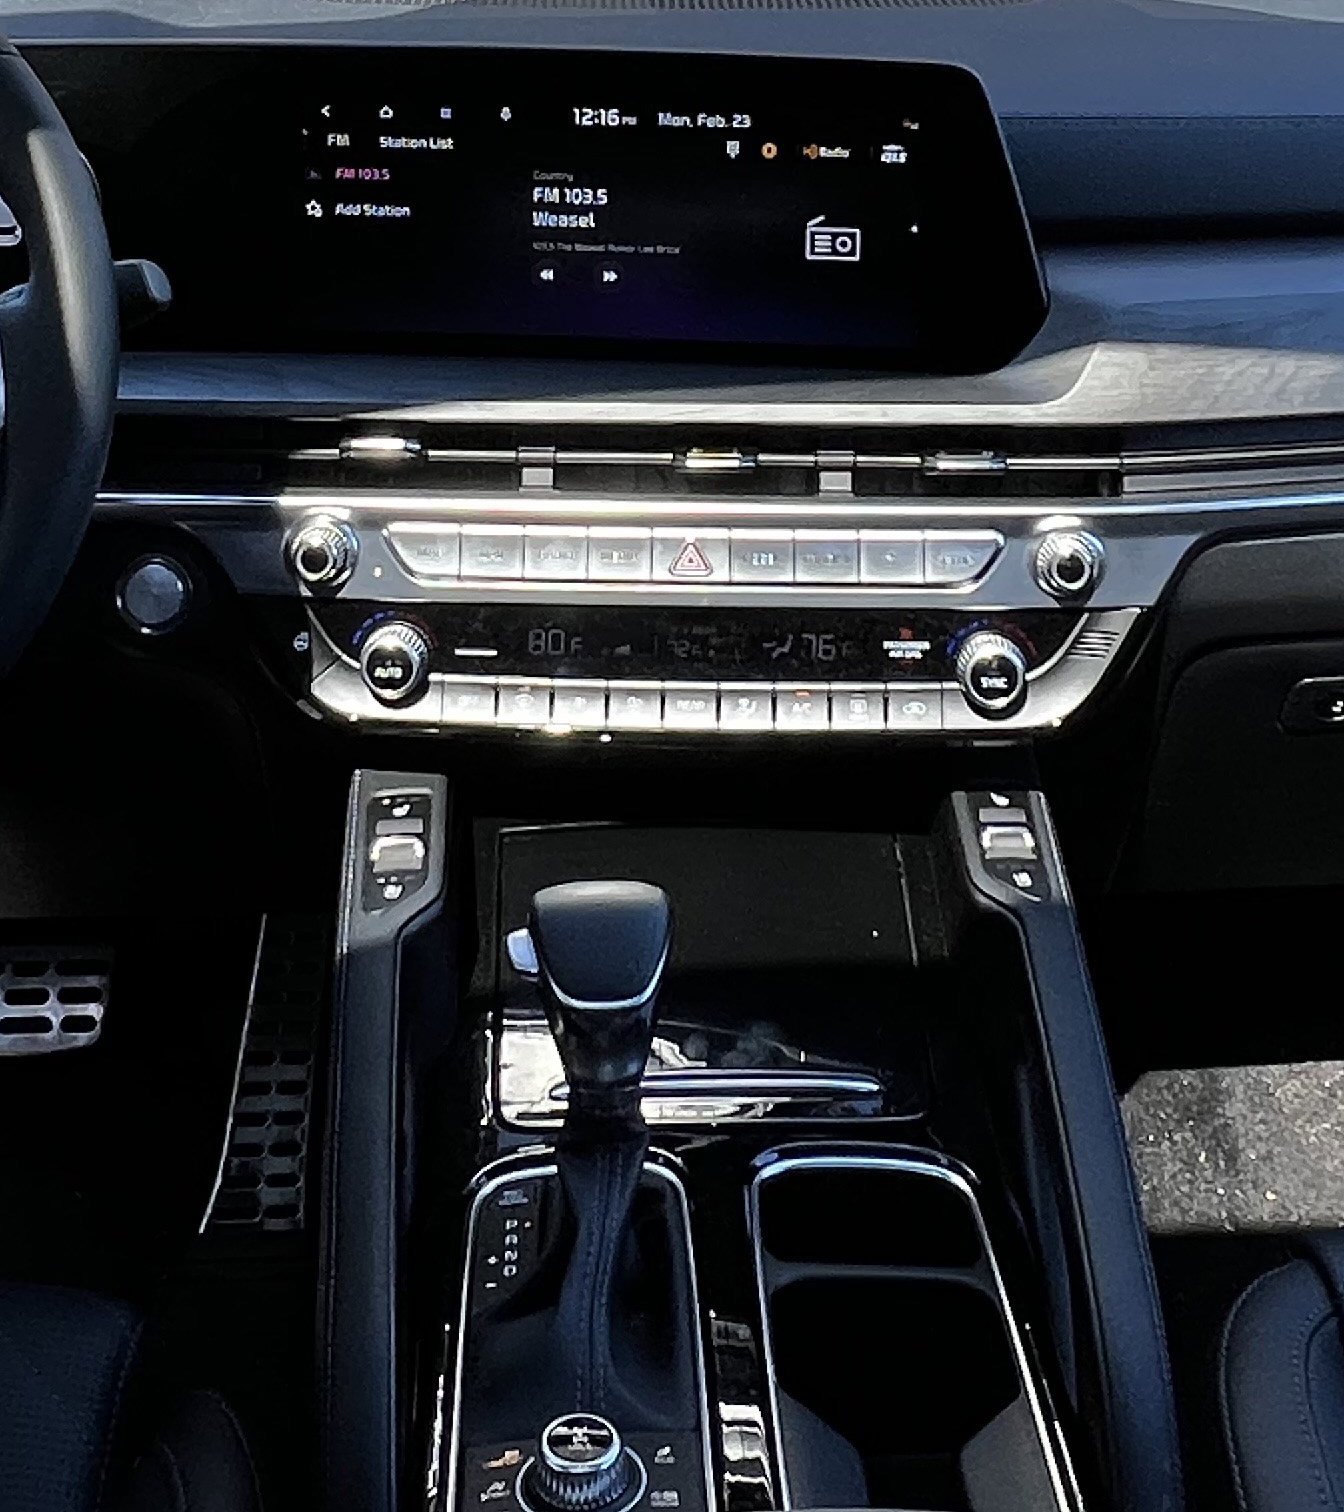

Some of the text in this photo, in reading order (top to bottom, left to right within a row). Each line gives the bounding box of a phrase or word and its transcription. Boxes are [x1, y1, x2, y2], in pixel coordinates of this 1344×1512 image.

[572, 108, 620, 126] 12:16
[733, 114, 752, 128] 23
[326, 133, 351, 147] FM
[378, 136, 455, 150] Station List
[334, 168, 390, 181] FM 103.5
[532, 187, 608, 206] FM 103.5
[334, 203, 411, 218] Add Station
[532, 211, 596, 229] Weasel
[505, 1218, 518, 1230] P
